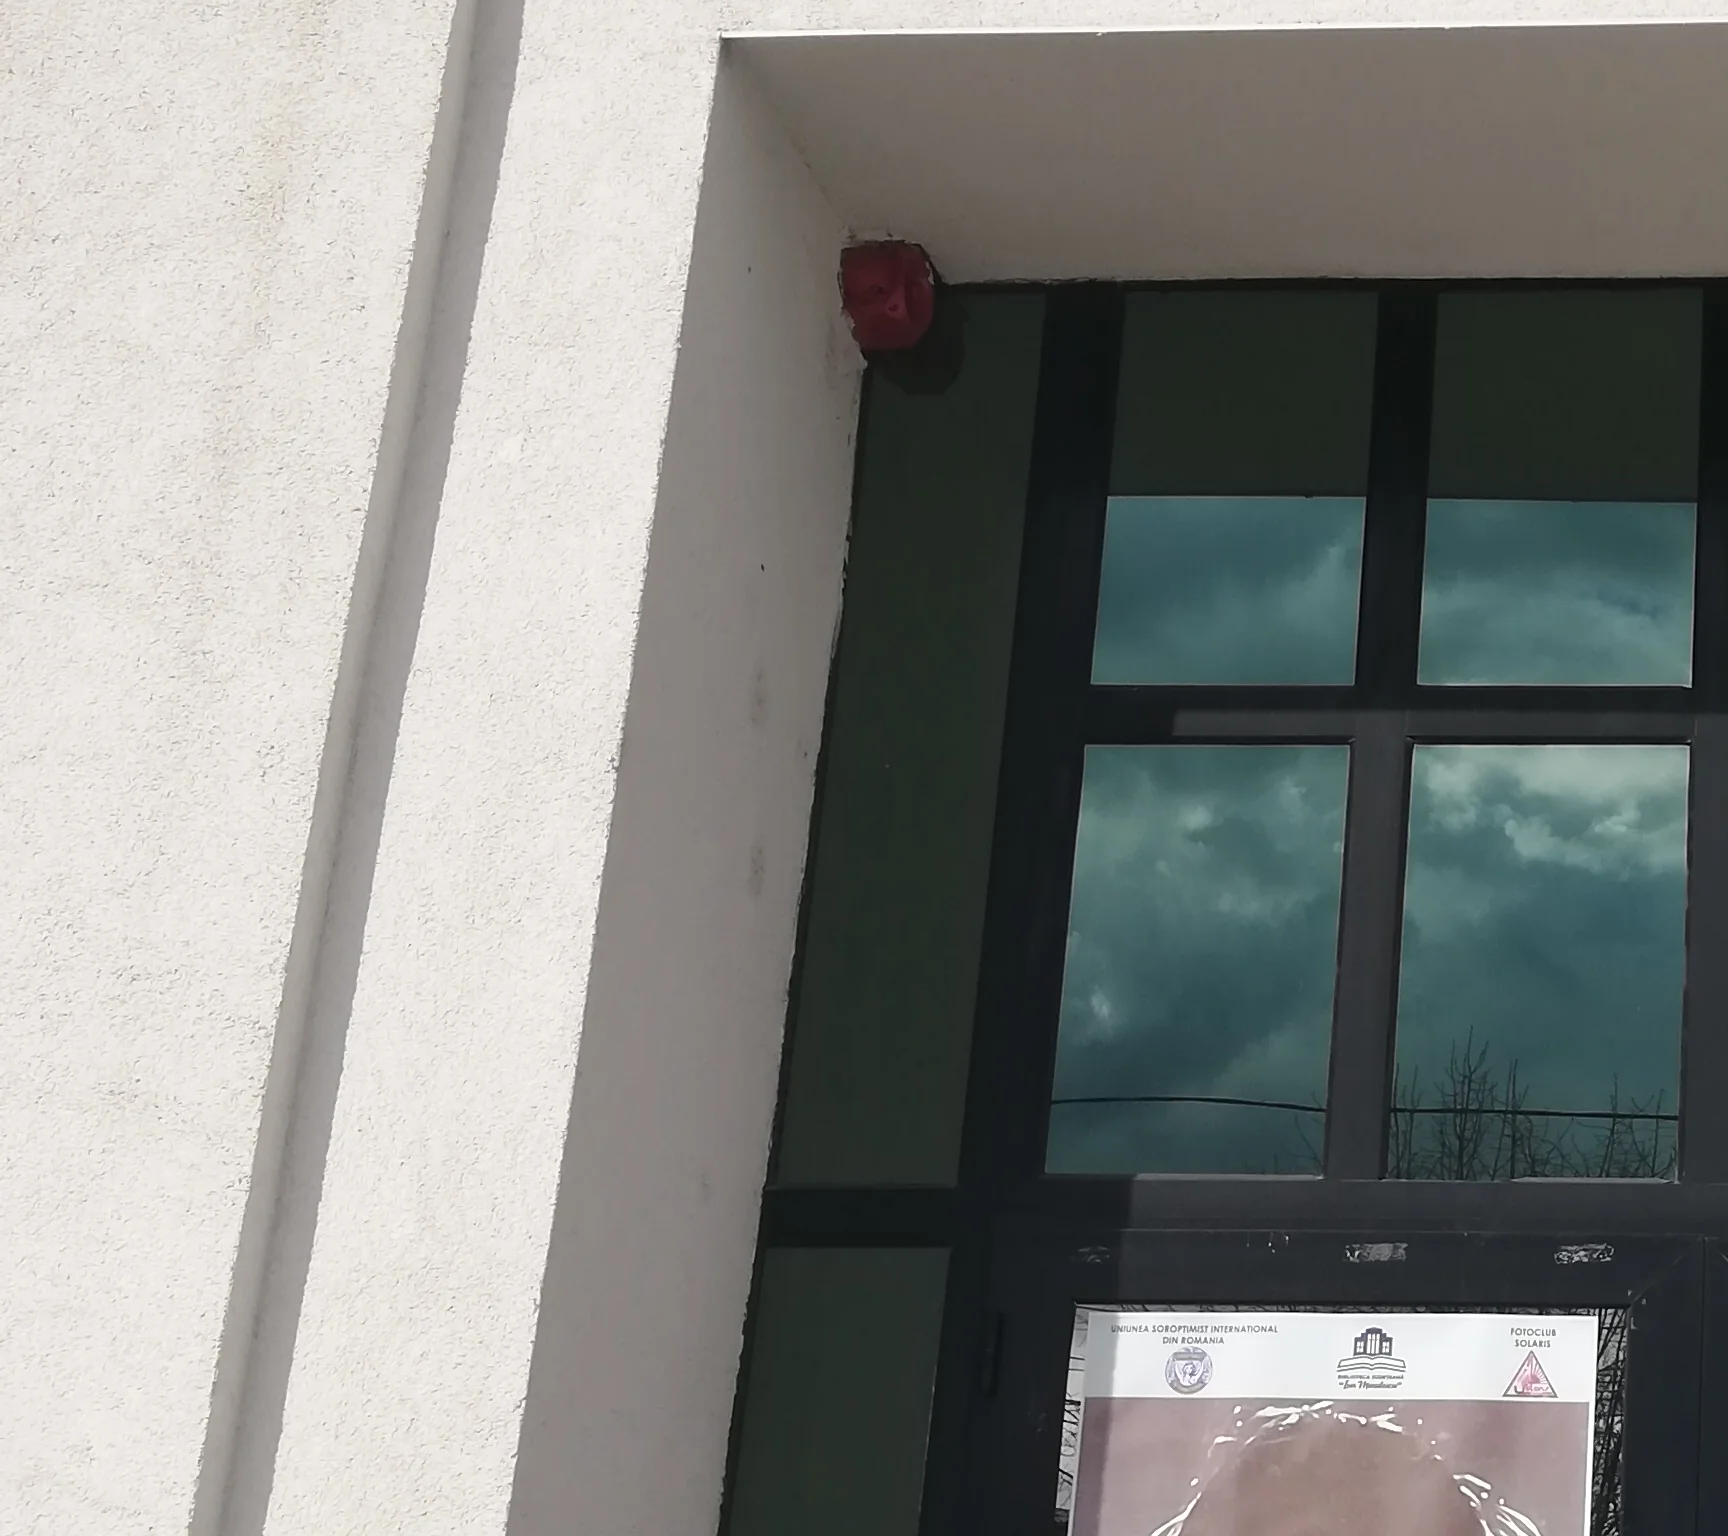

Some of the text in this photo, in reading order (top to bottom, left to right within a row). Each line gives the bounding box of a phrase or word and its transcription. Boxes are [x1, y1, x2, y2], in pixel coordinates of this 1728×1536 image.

[1111, 1325, 1278, 1334] UNIUNEA SOROPTIMIST INTERNATIONAL
[1510, 1327, 1556, 1337] FOTOCLUB
[1162, 1336, 1225, 1344] DIN ROMANIA
[1514, 1338, 1551, 1348] SOLARIS
